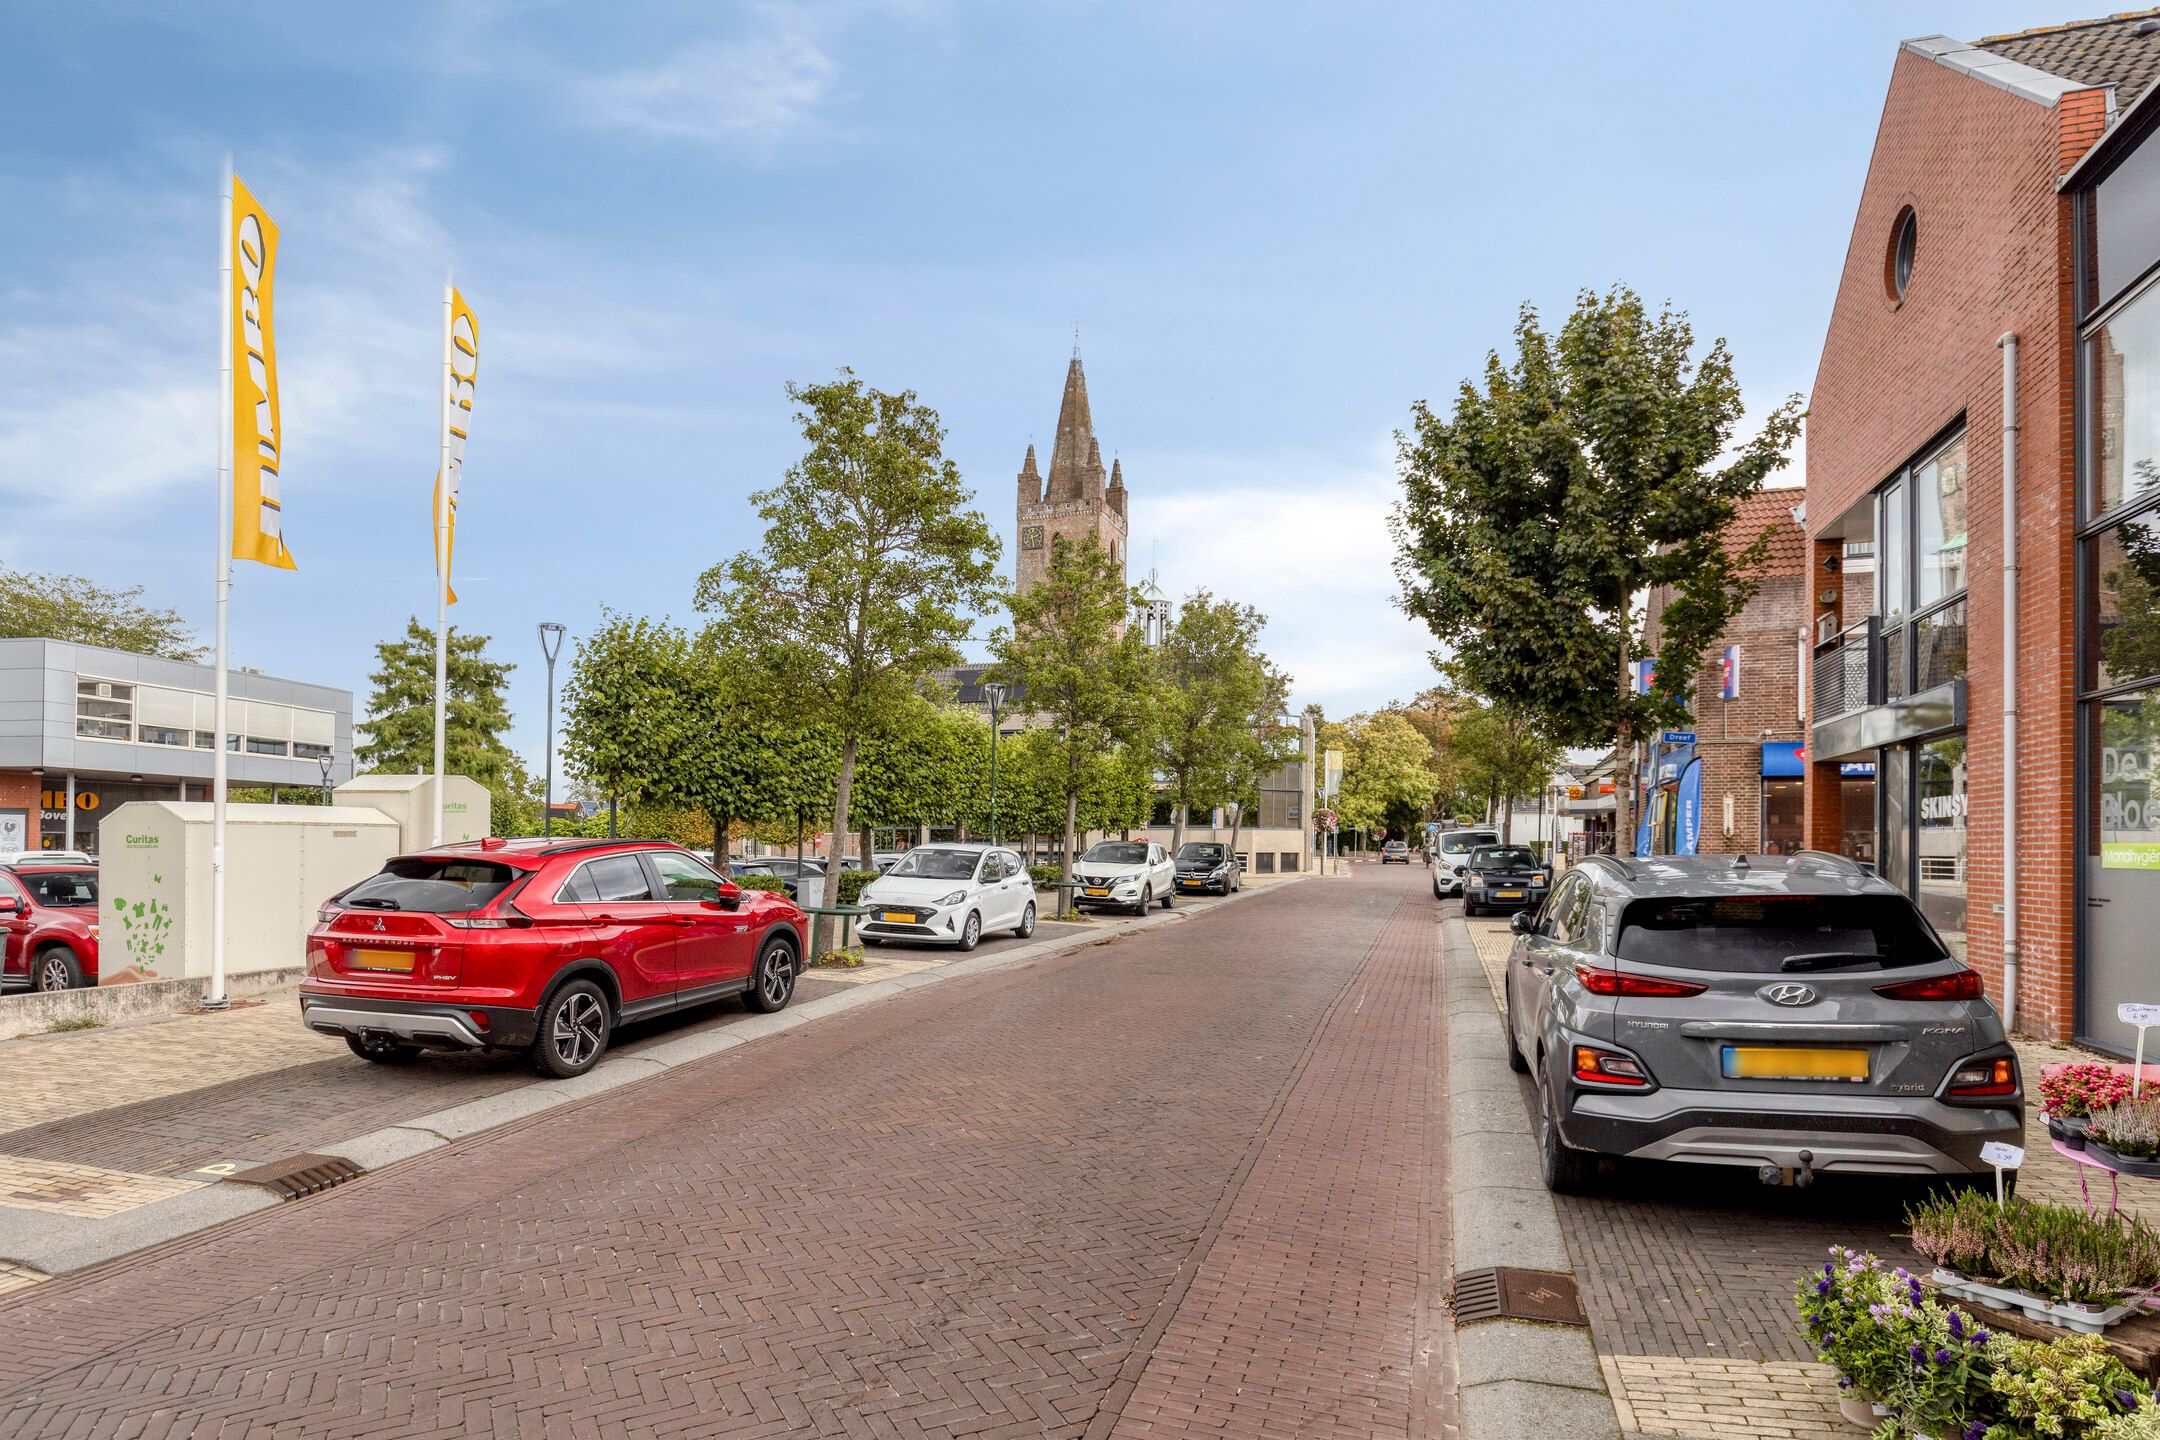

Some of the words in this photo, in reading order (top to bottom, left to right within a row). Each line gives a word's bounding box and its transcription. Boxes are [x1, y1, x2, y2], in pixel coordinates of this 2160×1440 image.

[2102, 747, 2138, 783] De
[443, 801, 467, 810] uritas
[40, 810, 68, 820] Bove
[1686, 799, 1694, 855] AMPER
[126, 834, 159, 844] Curitas
[1627, 1020, 1669, 1030] HYUNDAI
[1922, 1027, 1965, 1035] KONA
[1891, 1082, 1925, 1093] hybrid
